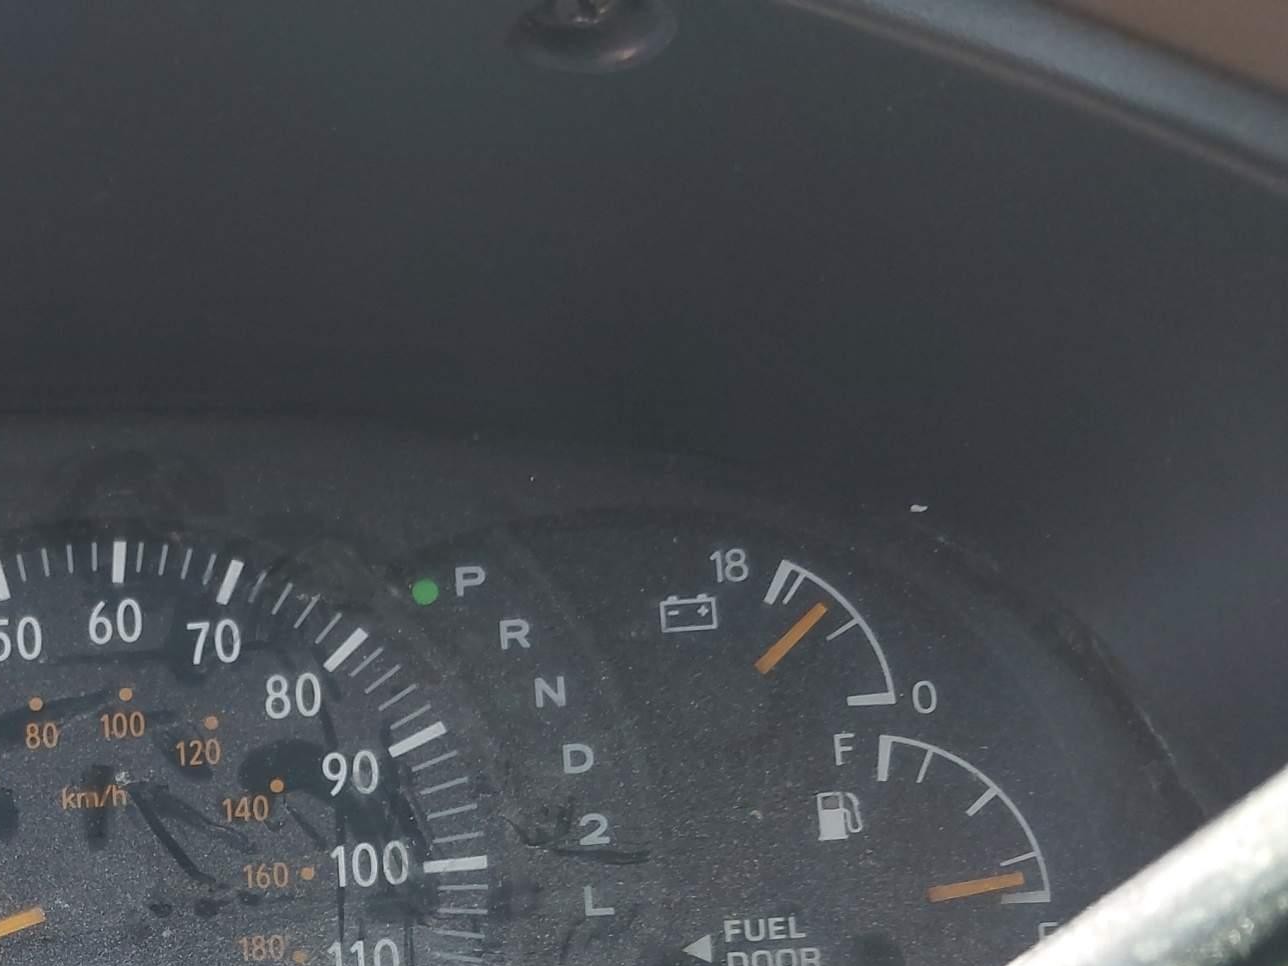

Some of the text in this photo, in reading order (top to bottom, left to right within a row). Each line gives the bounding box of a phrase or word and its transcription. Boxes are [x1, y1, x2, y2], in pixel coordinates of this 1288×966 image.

[711, 548, 748, 583] 18
[455, 566, 486, 596] P
[89, 599, 142, 645] 60
[500, 619, 530, 650] R
[186, 619, 241, 665] 70
[264, 673, 321, 718] 80
[535, 676, 565, 707] N
[913, 681, 937, 714] 0
[25, 721, 59, 749] 80
[99, 712, 144, 738] 100
[175, 739, 220, 767] 120
[563, 745, 593, 774] D
[834, 733, 854, 767] F
[321, 751, 378, 796] 90
[62, 785, 126, 810] km/h
[222, 795, 268, 821] 140
[580, 814, 610, 845] 2
[243, 862, 288, 888] 160
[330, 841, 408, 888] 100
[585, 886, 615, 916] L
[723, 917, 806, 942] FUEL
[238, 935, 285, 960] 180
